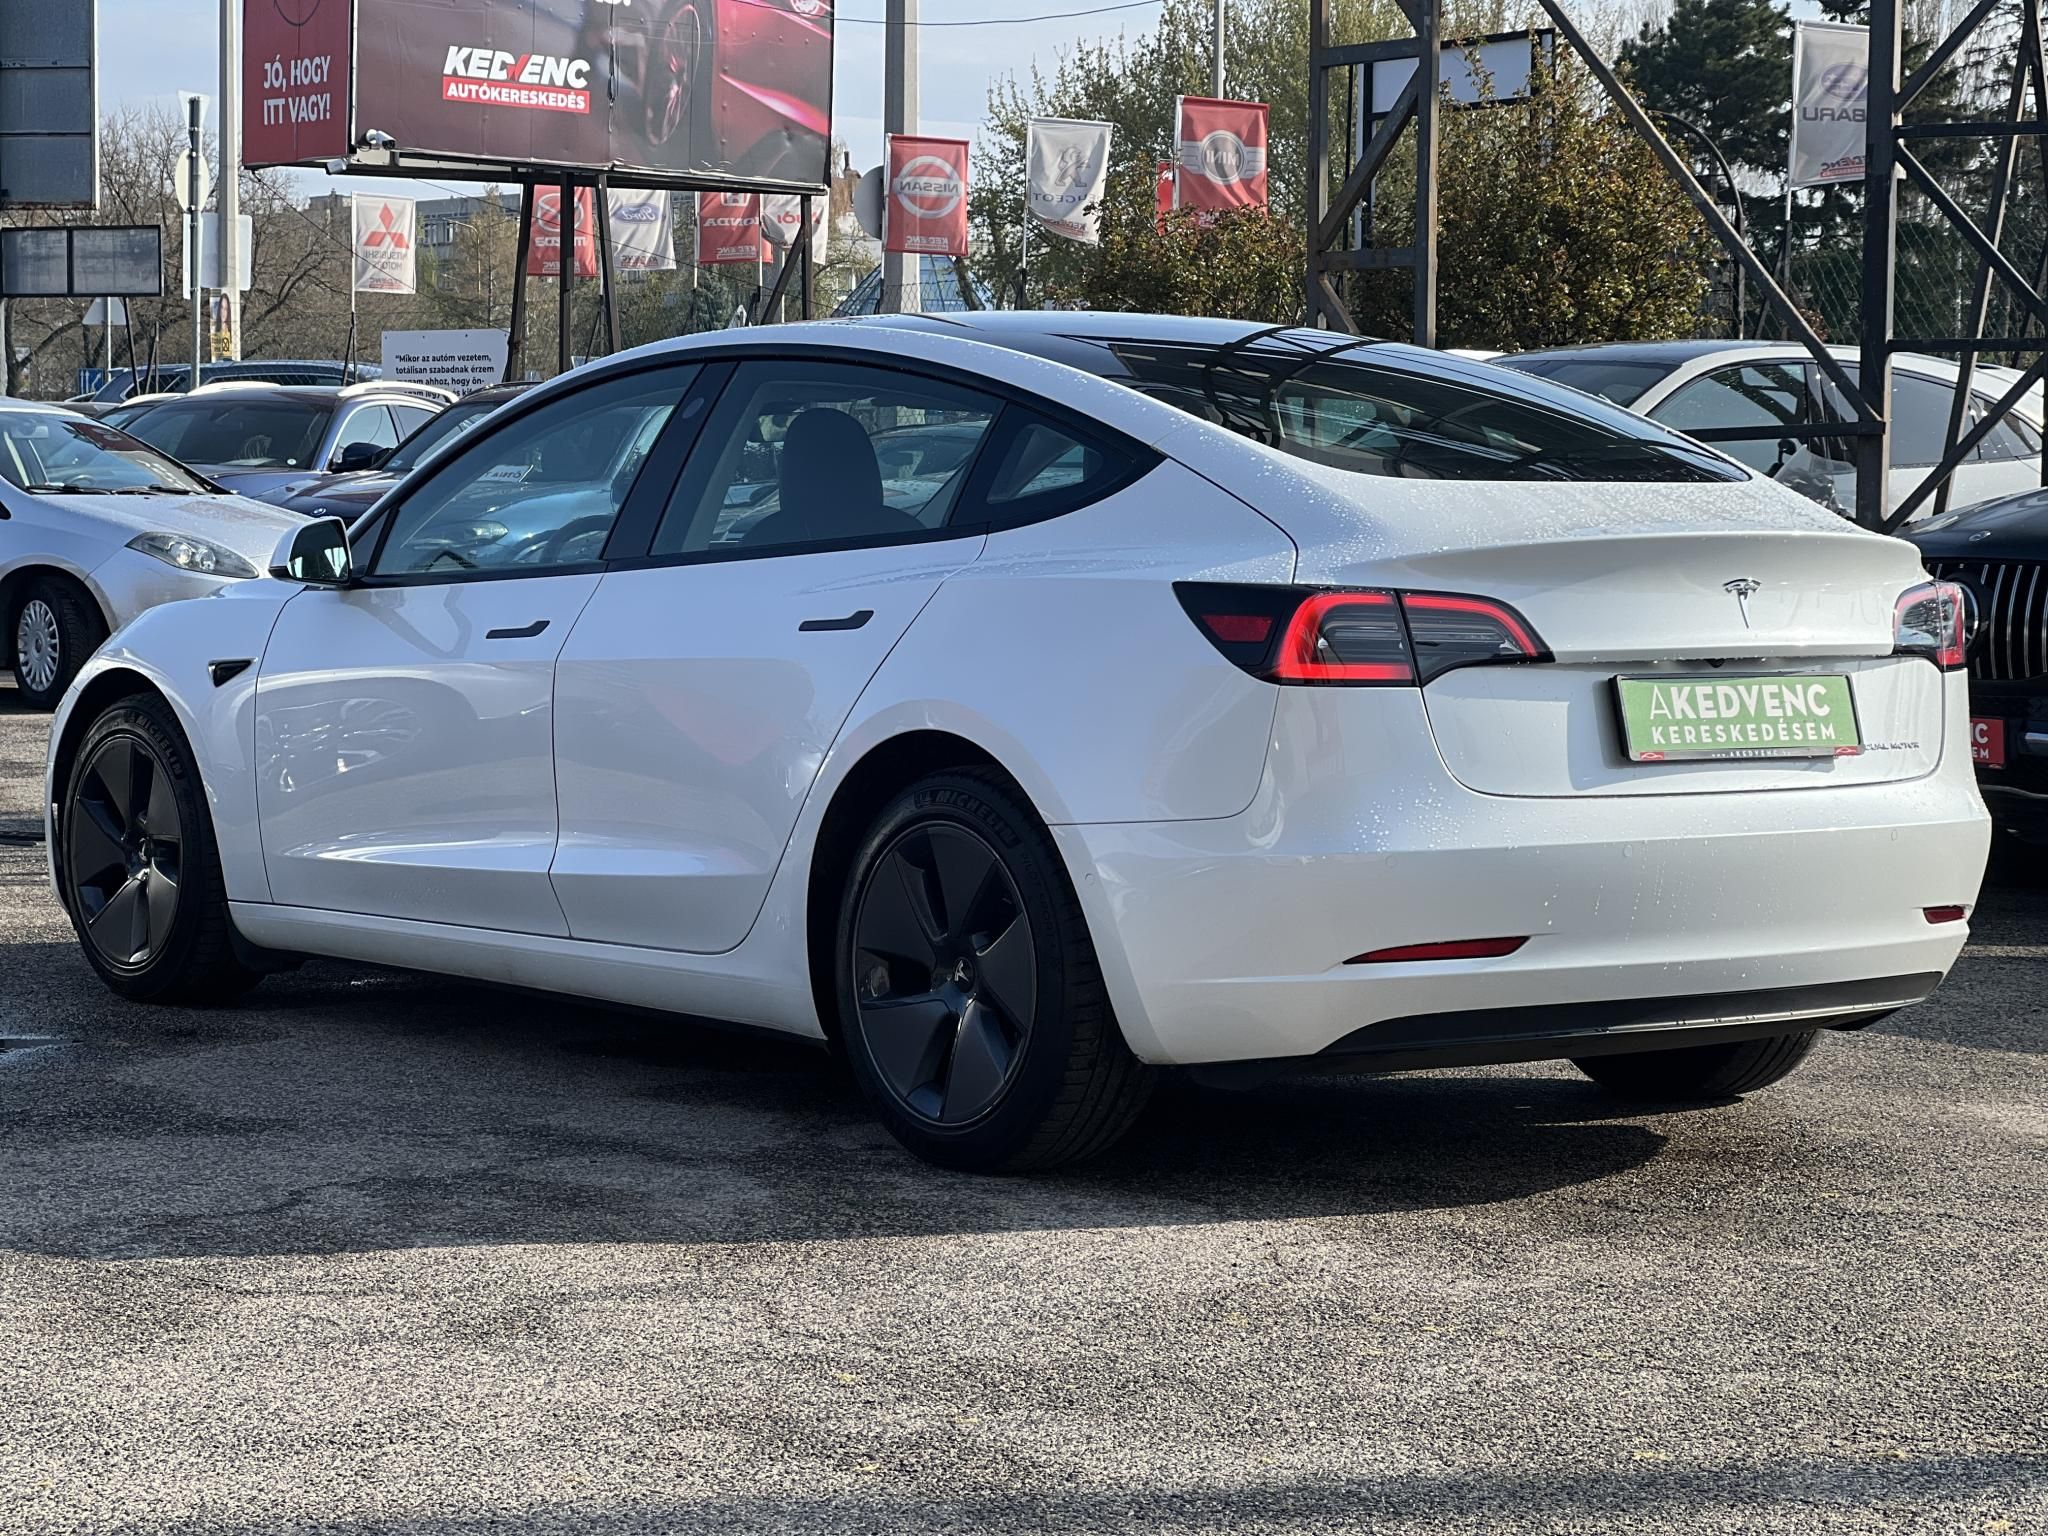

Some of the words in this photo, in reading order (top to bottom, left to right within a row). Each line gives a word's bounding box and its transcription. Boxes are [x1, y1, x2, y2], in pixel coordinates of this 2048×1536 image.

[263, 54, 286, 92] JÓ,
[290, 55, 331, 86] HOGY
[263, 98, 286, 126] ITT
[287, 93, 331, 123] VAGY!
[446, 82, 585, 110] AUTÓKERESKEDÉS
[395, 365, 428, 375] totálisan
[429, 365, 469, 374] szabadnak
[471, 364, 495, 373] érzem
[431, 354, 456, 362] autóm
[458, 353, 491, 363] vezetem,
[425, 377, 450, 386] ahhoz,
[451, 376, 470, 387] hogy
[1652, 717, 1837, 745] KERESKEDÉSEM
[936, 790, 1017, 847] MICHELIN
